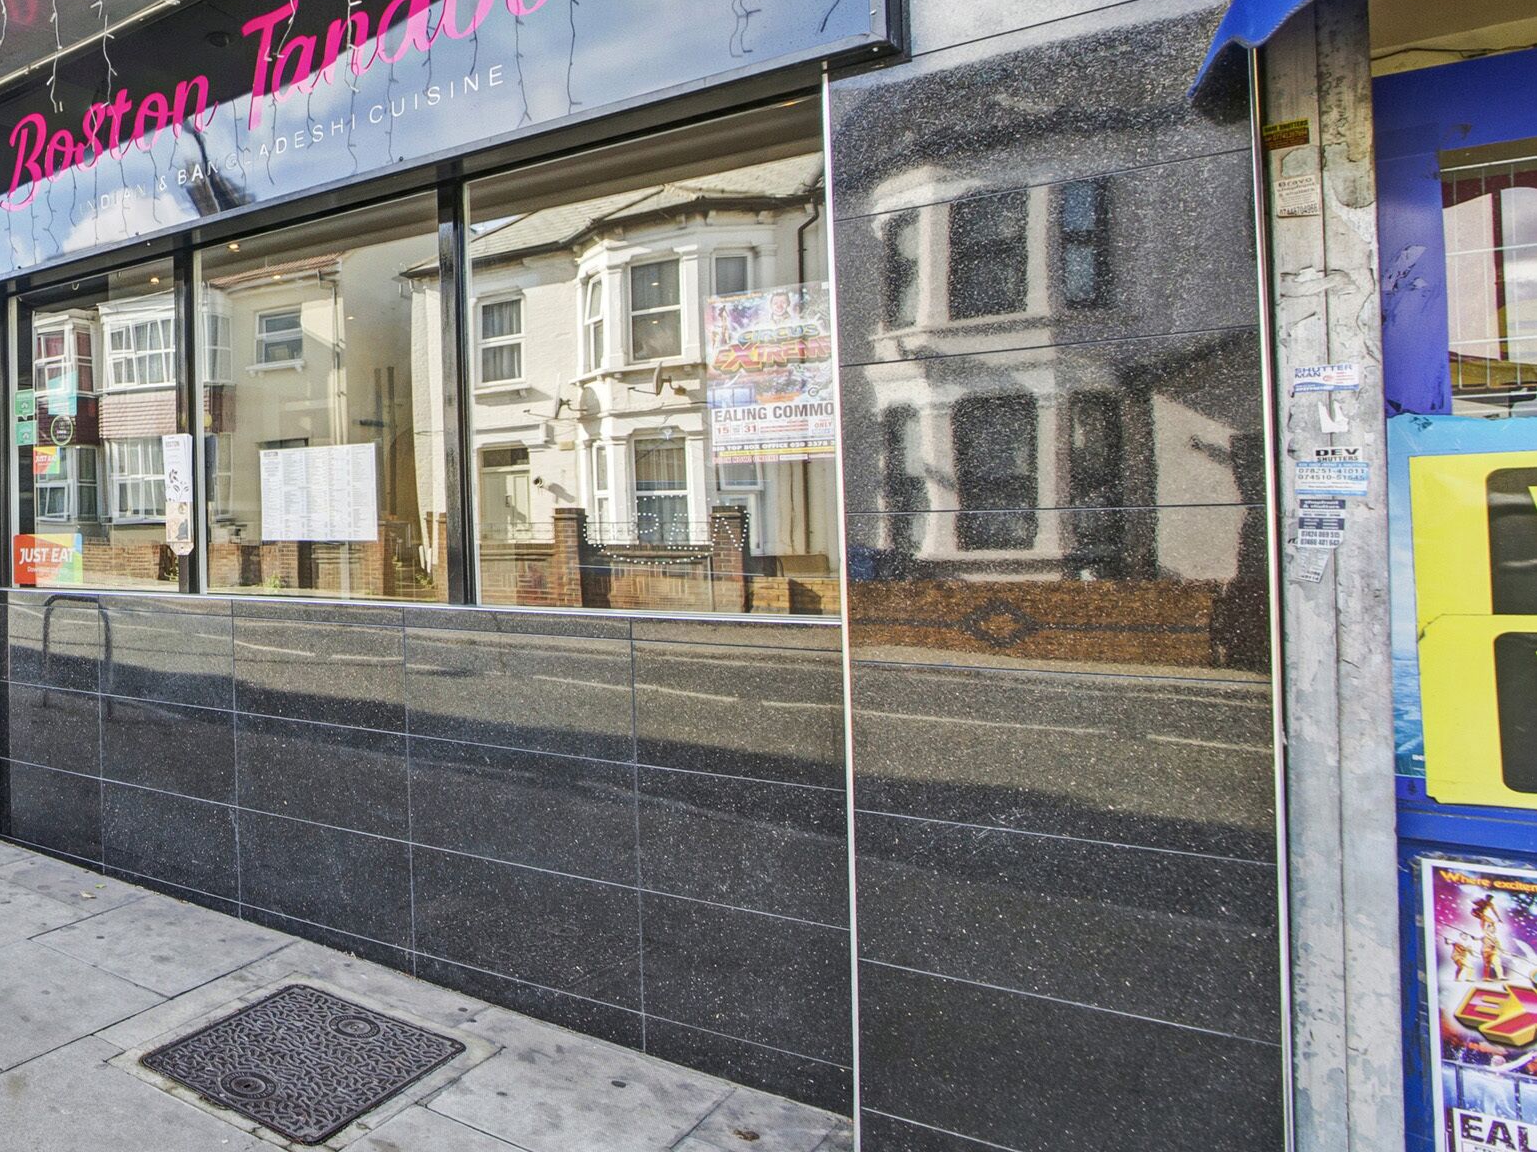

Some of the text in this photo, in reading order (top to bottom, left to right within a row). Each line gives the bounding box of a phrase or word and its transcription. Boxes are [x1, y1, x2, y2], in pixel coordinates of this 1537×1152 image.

[158, 176, 169, 192] &
[178, 115, 359, 186] BANGLADESHI
[369, 63, 505, 124] CUISINE
[0, 74, 219, 212] Boston
[714, 407, 768, 423] EALING
[744, 424, 757, 433] 31
[1315, 448, 1359, 456] DEV
[19, 547, 74, 565] JUST EAT
[1439, 869, 1491, 888] Where
